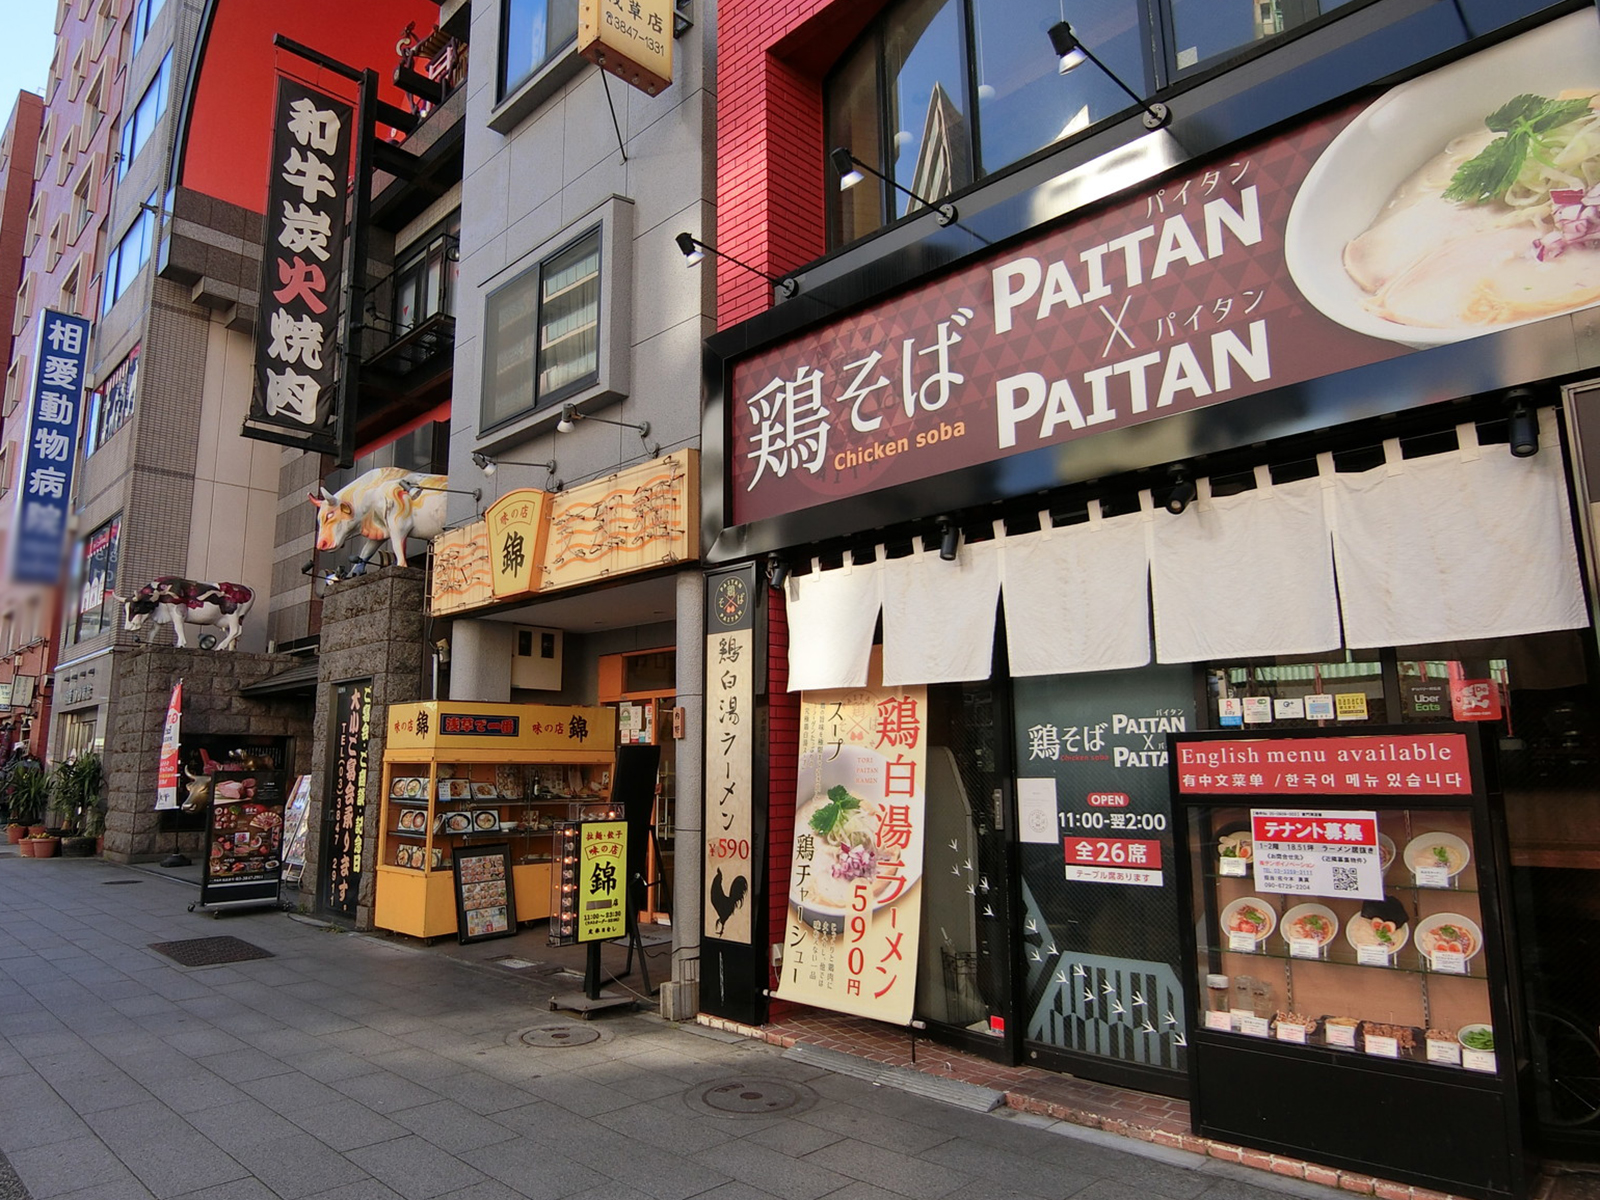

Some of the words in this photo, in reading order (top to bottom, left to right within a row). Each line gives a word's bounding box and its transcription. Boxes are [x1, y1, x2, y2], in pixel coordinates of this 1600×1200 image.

[1147, 161, 1250, 218] パイタン
[267, 97, 341, 425] 和牛炭火焼肉
[992, 185, 1262, 335] PAITAN
[1156, 290, 1264, 341] パイタン
[747, 307, 974, 492] 鶏そば
[996, 320, 1270, 449] PAITAN
[834, 437, 909, 470] Chicken
[916, 421, 965, 448] soba
[500, 504, 529, 525] 味の店
[501, 530, 526, 579] 錦
[1413, 694, 1440, 703] Uber
[1415, 703, 1441, 711] Eats
[394, 719, 413, 733] 味の店
[416, 710, 429, 740] 錦
[445, 717, 514, 735] 浅草で一番
[532, 721, 564, 735] 味の店
[568, 715, 589, 743] 錦
[718, 635, 743, 831] 鶏白湯ラーメン
[827, 702, 844, 762] スープ
[1112, 714, 1186, 735] PAITAN
[1028, 723, 1109, 761] 鶏そば
[1181, 747, 1260, 768] English
[1266, 748, 1326, 764] menu
[1337, 742, 1451, 763] available
[1182, 773, 1265, 787] 有中文菜单
[1345, 774, 1379, 788] 메뉴
[1387, 773, 1462, 788] 있습니다
[1090, 795, 1124, 805] OPEN
[1058, 811, 1166, 831] 11:00-翌2:00
[1264, 821, 1363, 841] テナント募集
[588, 845, 619, 855] 味の店
[708, 838, 749, 860] ¥590
[874, 695, 920, 999] 鶏白湯ラーメン
[1075, 841, 1147, 864] 全26席
[329, 857, 338, 908] 2911
[589, 861, 617, 896] 錦
[1076, 870, 1150, 882] テーブル席あります
[790, 834, 815, 984] 鶏チャーシュー
[847, 885, 867, 997] 590円
